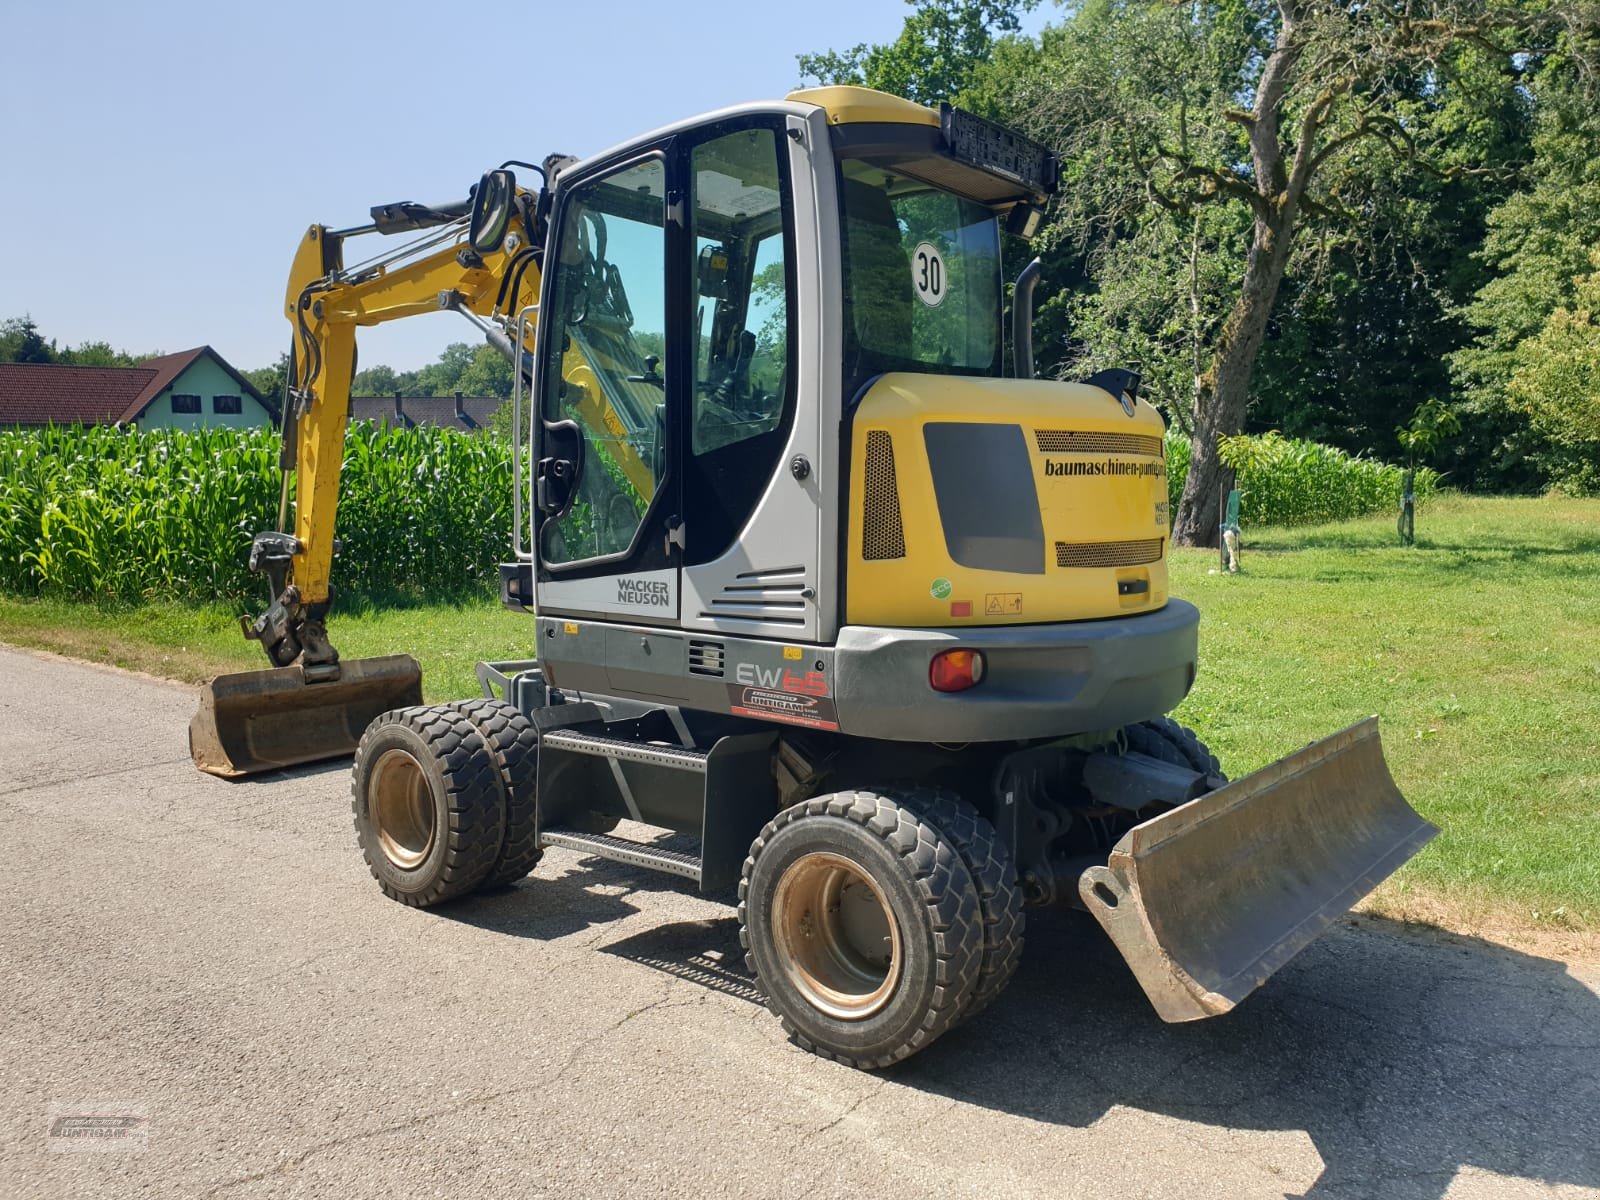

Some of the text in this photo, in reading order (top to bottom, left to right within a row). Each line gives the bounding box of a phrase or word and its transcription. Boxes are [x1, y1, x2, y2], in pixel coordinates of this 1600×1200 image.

[918, 252, 941, 295] 30
[617, 578, 669, 594] WACKER
[617, 590, 669, 606] NEUSON
[736, 662, 829, 696] EW65
